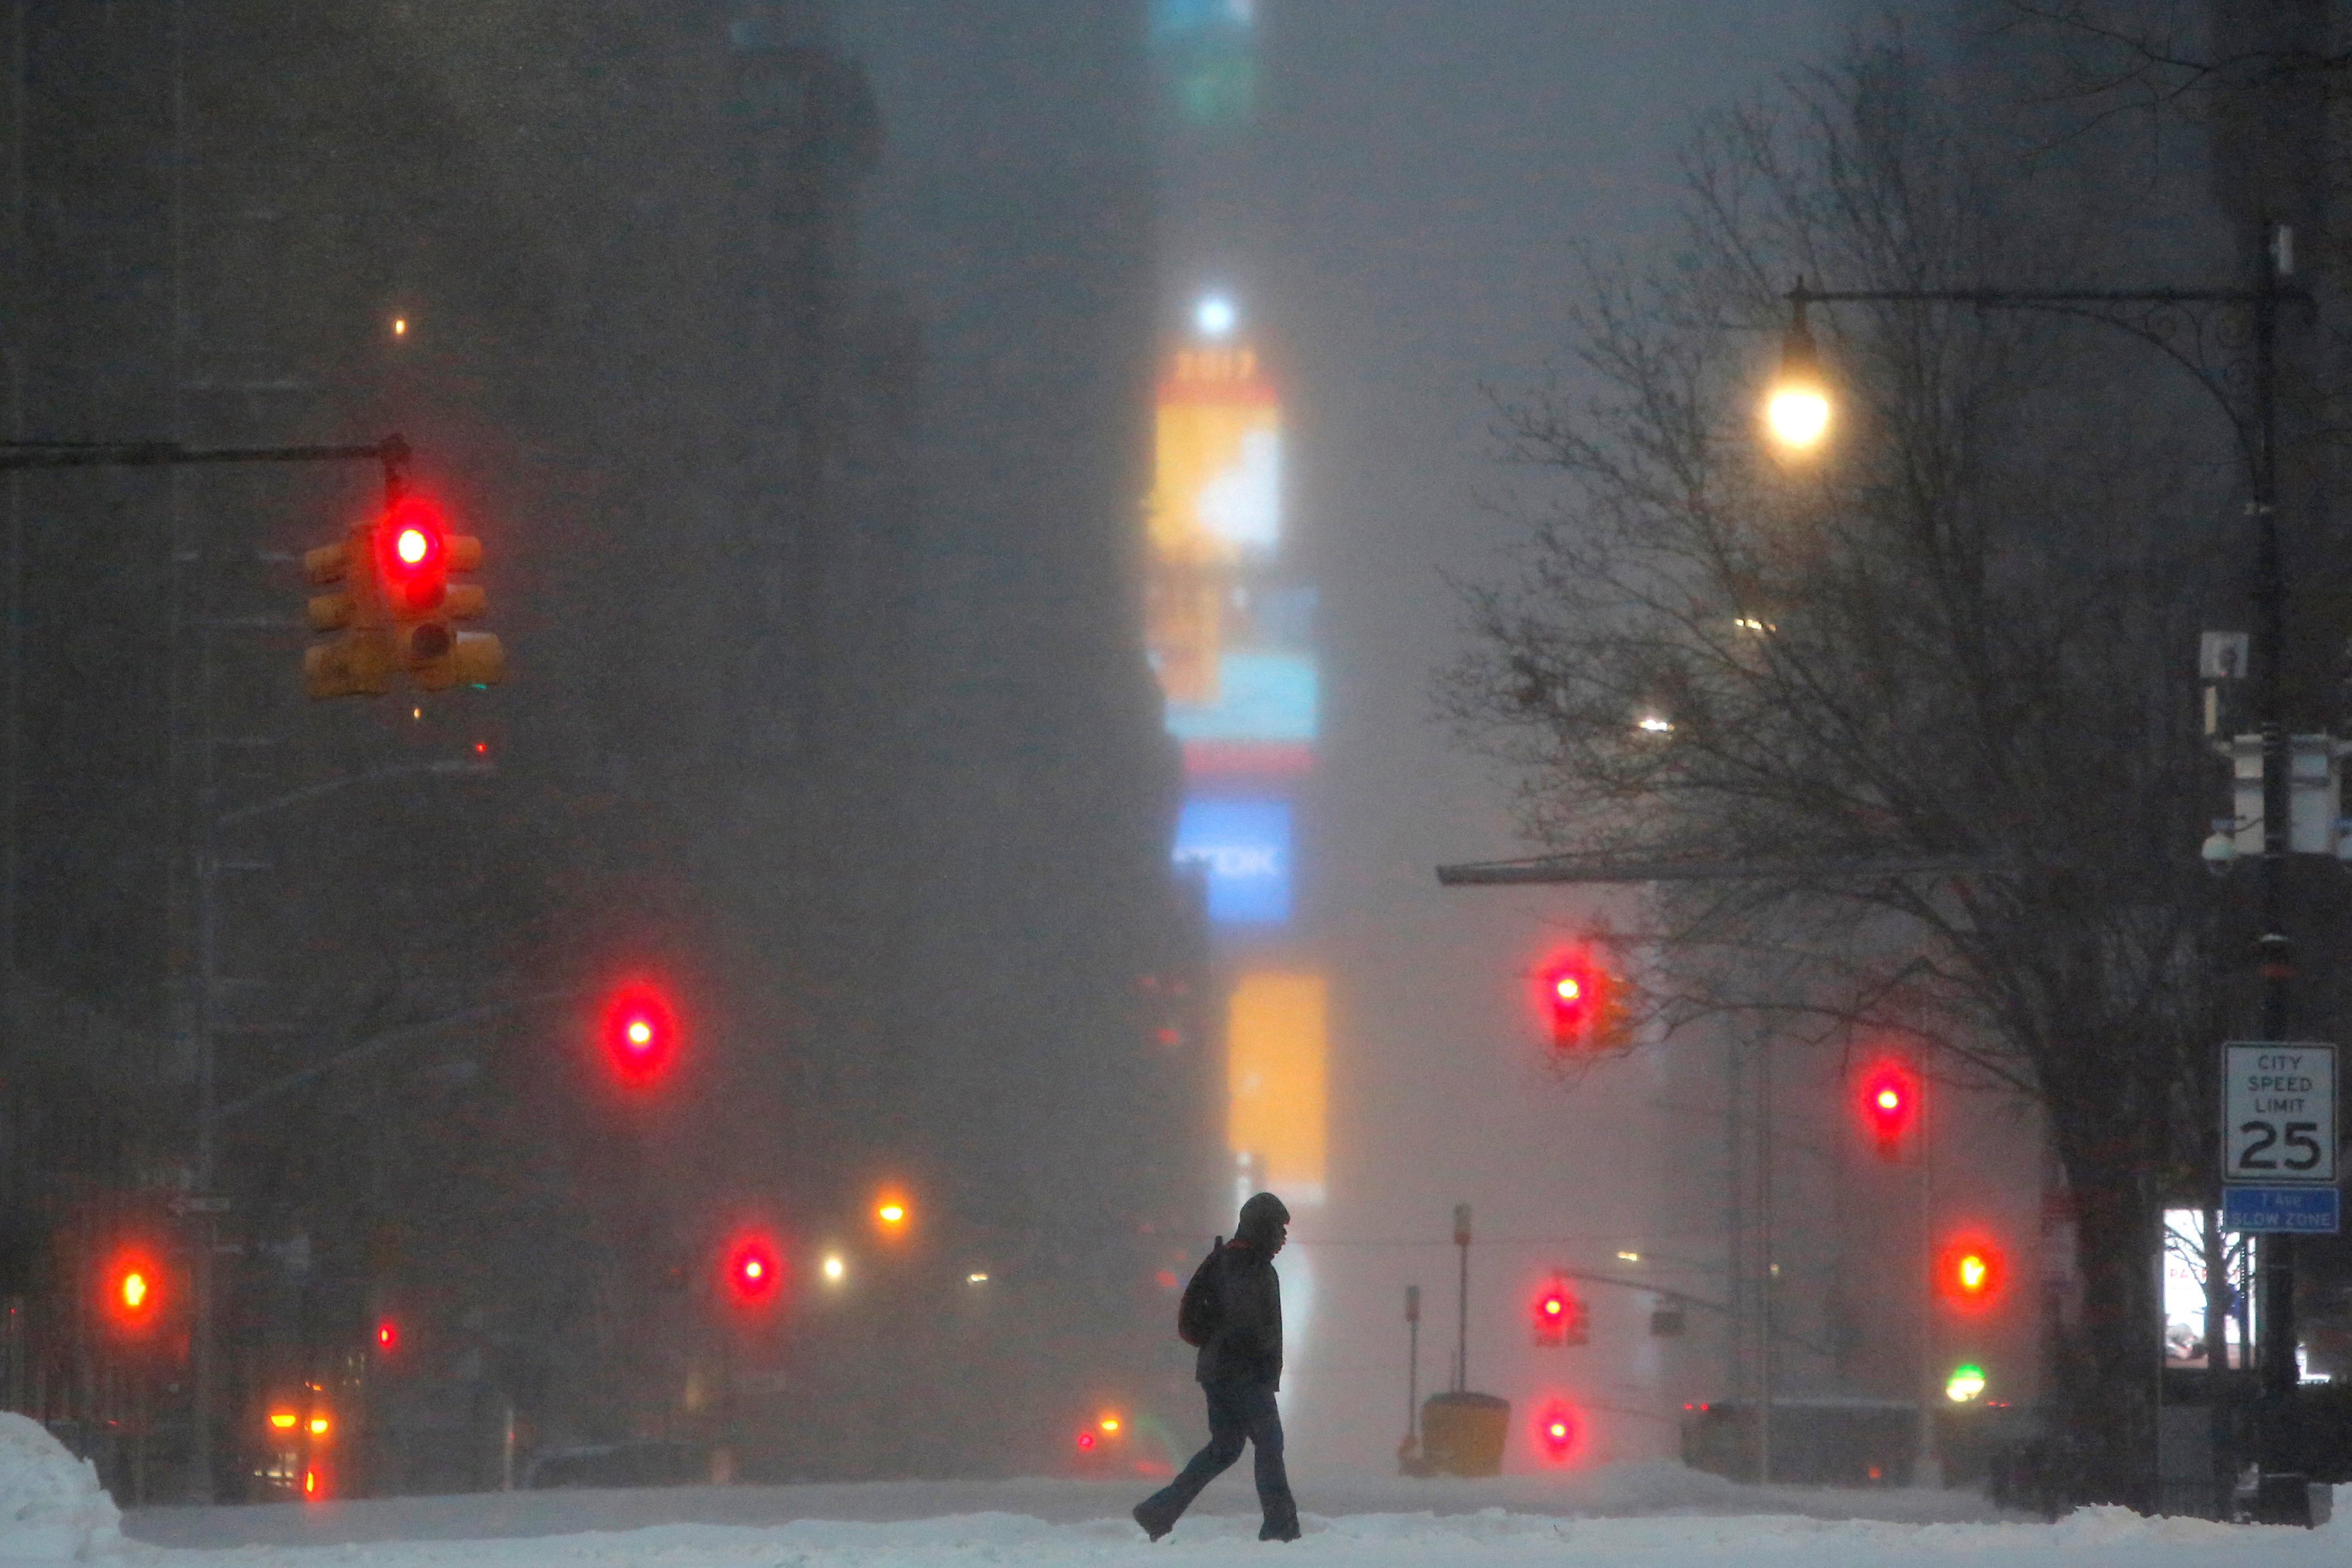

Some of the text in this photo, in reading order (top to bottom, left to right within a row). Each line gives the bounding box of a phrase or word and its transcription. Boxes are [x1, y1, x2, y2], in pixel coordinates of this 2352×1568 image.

[2258, 1055, 2303, 1070] CITY
[2248, 1076, 2313, 1092] SPEED
[2255, 1098, 2305, 1113] LIMIT
[2239, 1121, 2321, 1170] 25
[2230, 1212, 2331, 1227] SLOW ZONE
